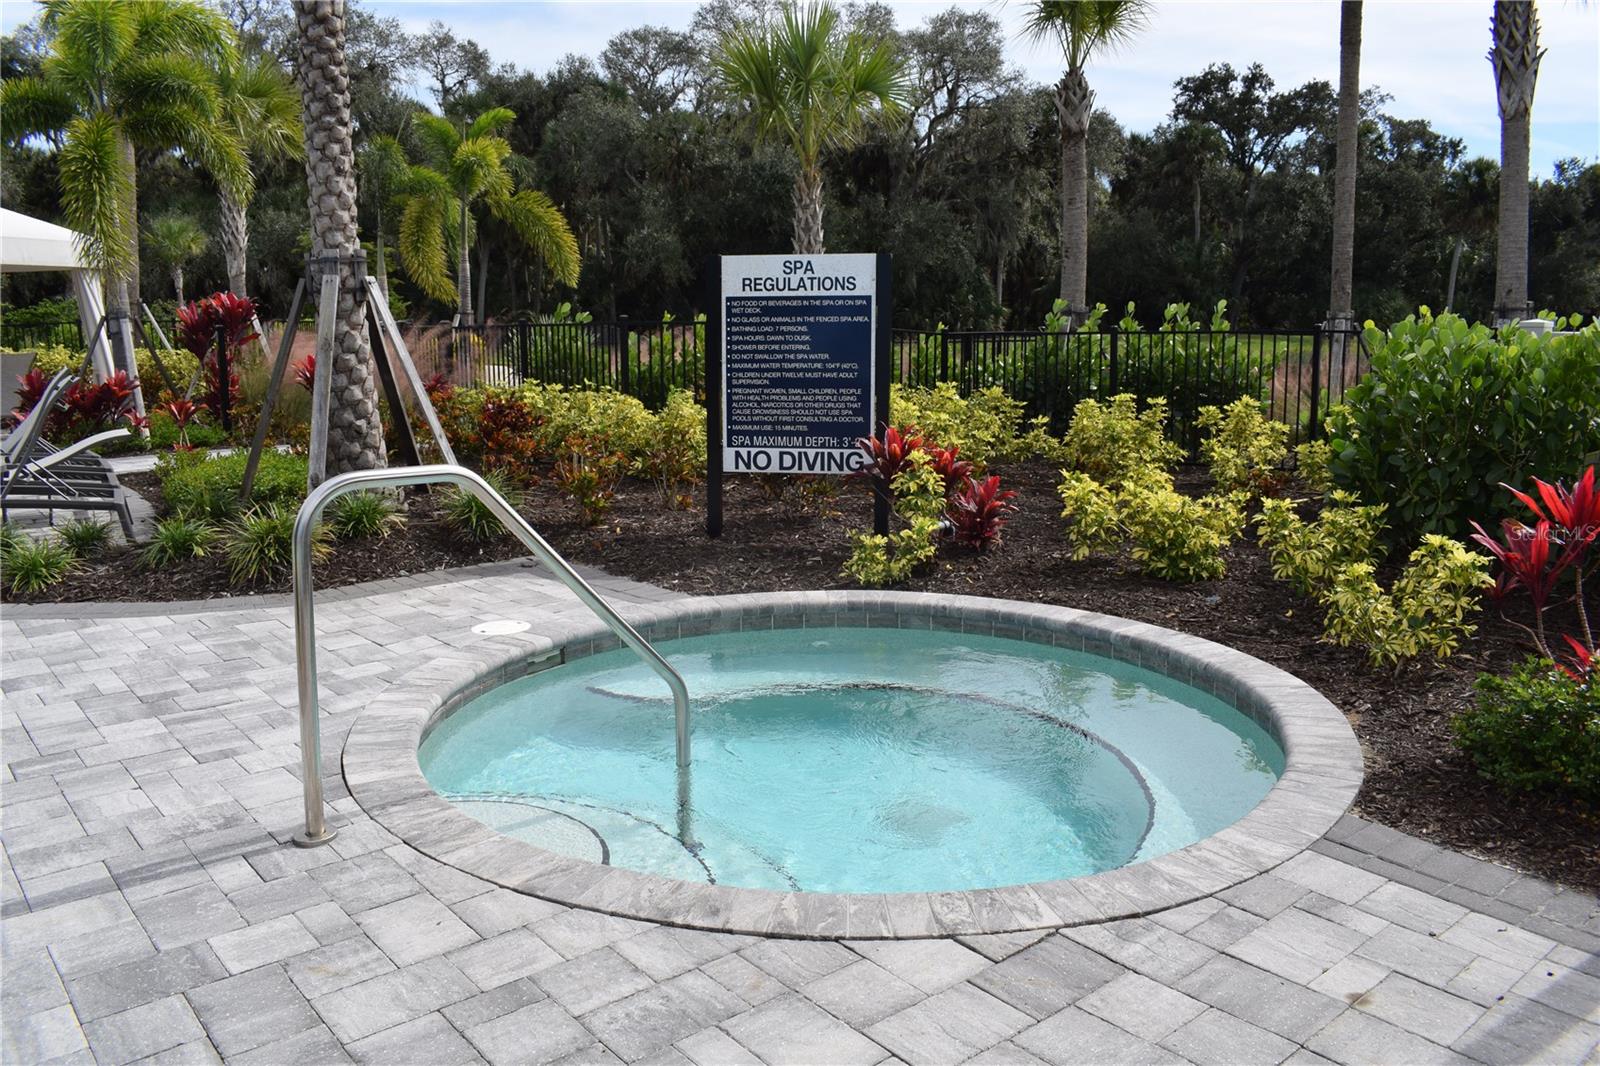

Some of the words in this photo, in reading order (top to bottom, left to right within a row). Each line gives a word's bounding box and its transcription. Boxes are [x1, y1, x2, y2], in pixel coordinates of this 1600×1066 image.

[782, 260, 815, 274] SPA
[742, 276, 857, 292] REGULATIONS
[732, 435, 751, 446] SPA
[753, 435, 803, 446] MAXIMUM
[805, 436, 840, 447] DEPTH:
[734, 450, 772, 470] NO
[778, 450, 864, 471] DIVING
